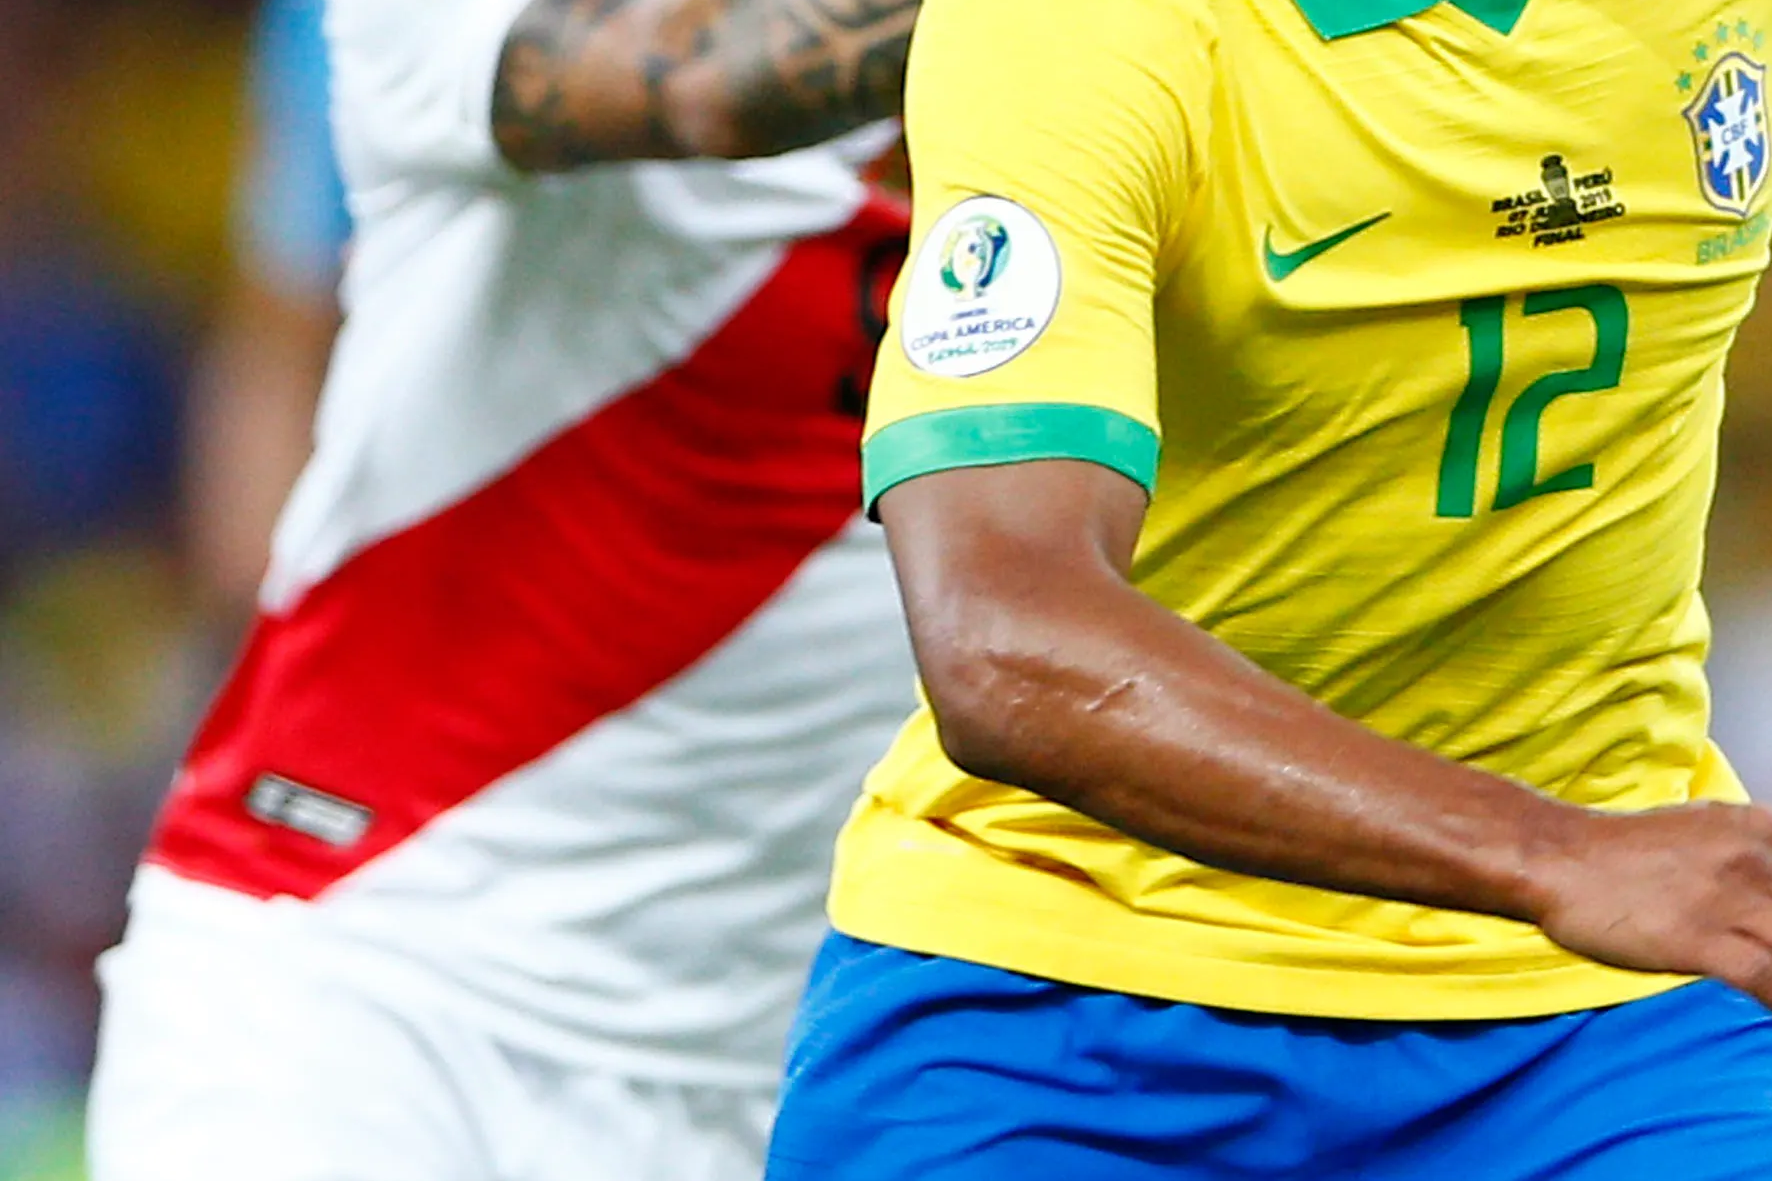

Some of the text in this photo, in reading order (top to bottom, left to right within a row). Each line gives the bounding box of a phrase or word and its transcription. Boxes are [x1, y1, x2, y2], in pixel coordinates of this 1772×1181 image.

[1721, 119, 1748, 146] CBF
[1491, 166, 1612, 213] BRASIL PERÚ
[1495, 223, 1526, 238] RIO
[1533, 227, 1586, 248] FINAL
[910, 330, 949, 351] COPA
[1436, 283, 1629, 518] 12
